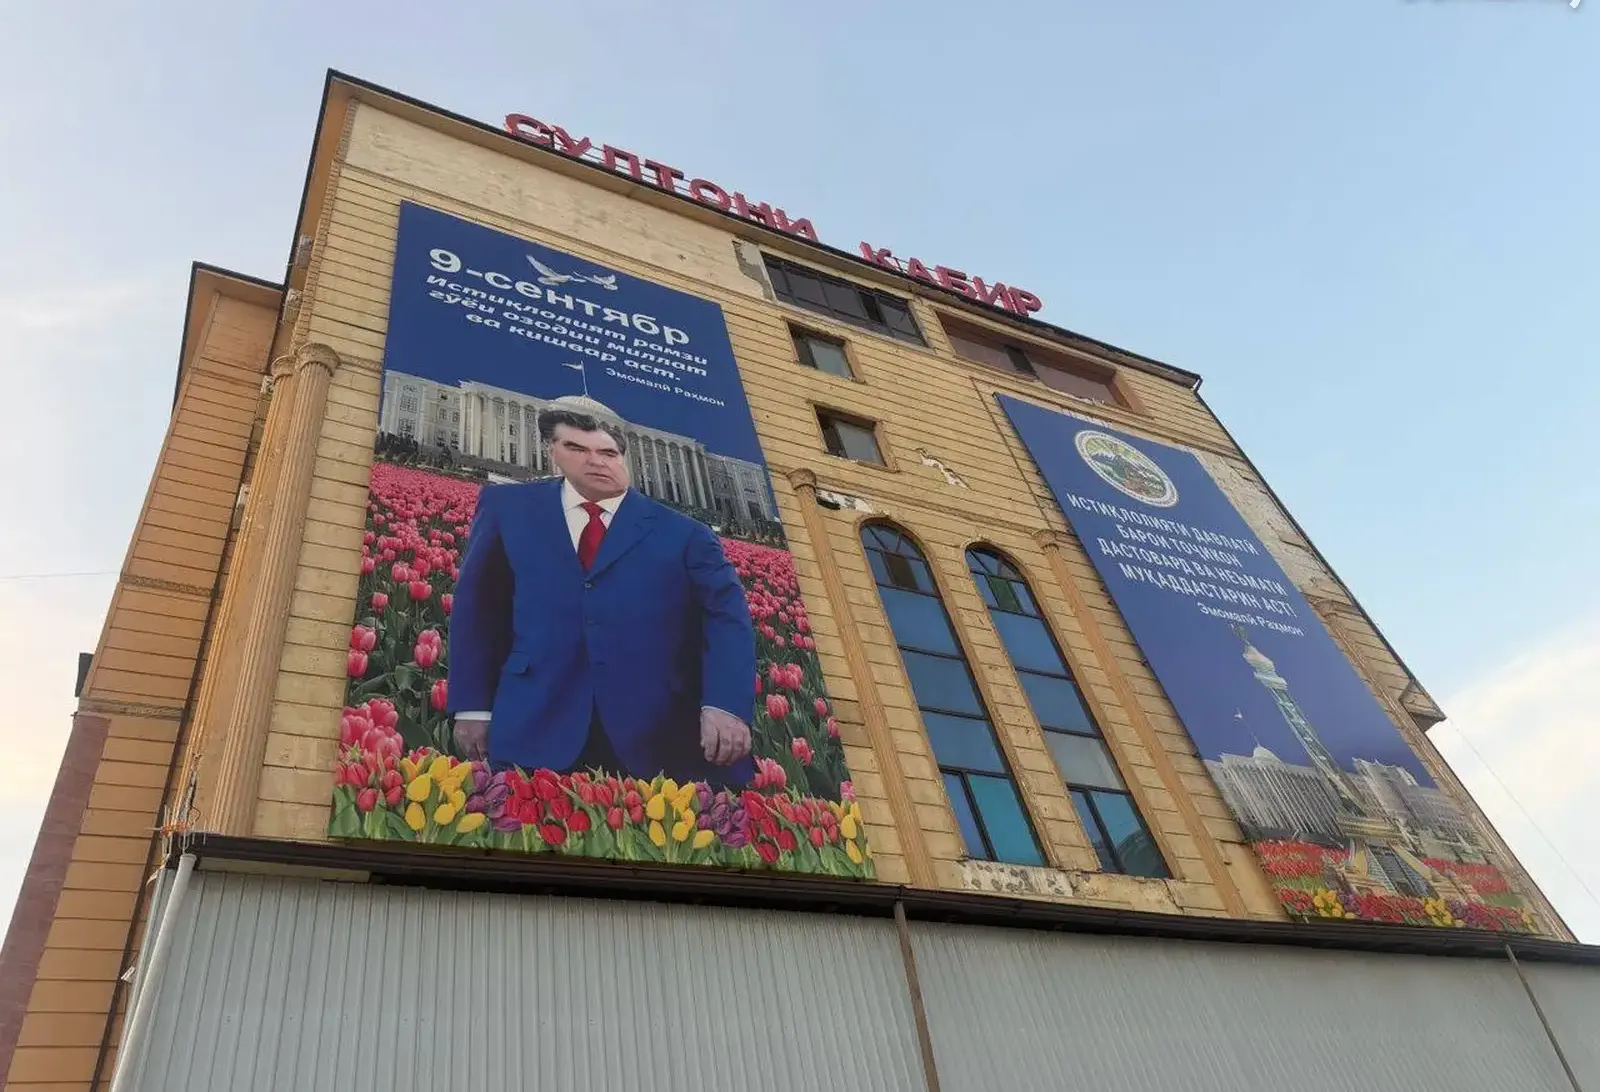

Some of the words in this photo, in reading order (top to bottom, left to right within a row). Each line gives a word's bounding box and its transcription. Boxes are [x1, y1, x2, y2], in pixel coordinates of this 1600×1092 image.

[429, 248, 689, 345] 9-сентябр
[859, 241, 1042, 315] КАБИР
[466, 314, 501, 329] ва
[509, 325, 617, 363] кишвар
[624, 359, 681, 381] аст.
[502, 311, 599, 346] озодии
[607, 341, 707, 376] миллат
[633, 337, 707, 366] рамзи
[1097, 537, 1195, 576] ДАСТОВАРД
[1192, 561, 1217, 579] ВА
[1214, 567, 1288, 597] НЕЪМАТИ
[1116, 524, 1171, 549] БАРОИ
[1261, 597, 1298, 619] АСТ!
